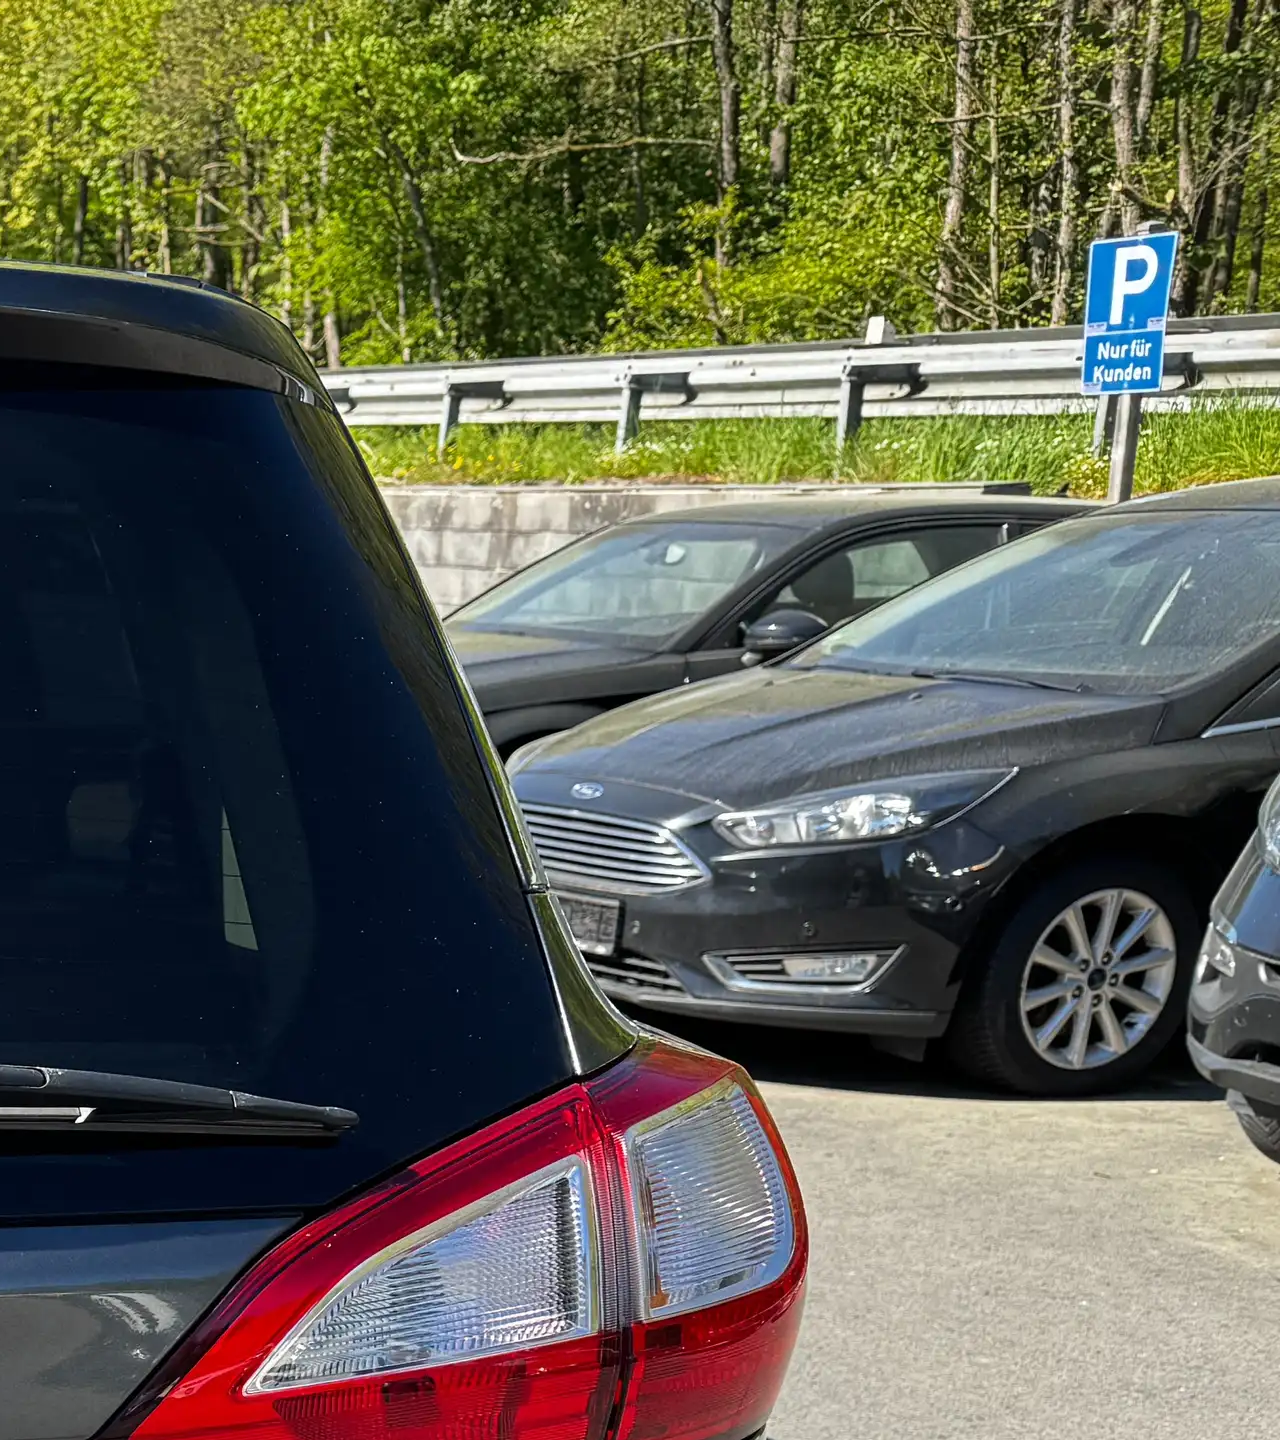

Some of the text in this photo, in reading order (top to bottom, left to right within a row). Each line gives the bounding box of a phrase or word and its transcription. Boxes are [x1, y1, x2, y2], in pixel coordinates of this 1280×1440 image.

[1109, 244, 1159, 326] P
[1097, 339, 1152, 361] Nur für
[1093, 362, 1152, 383] Kunden
